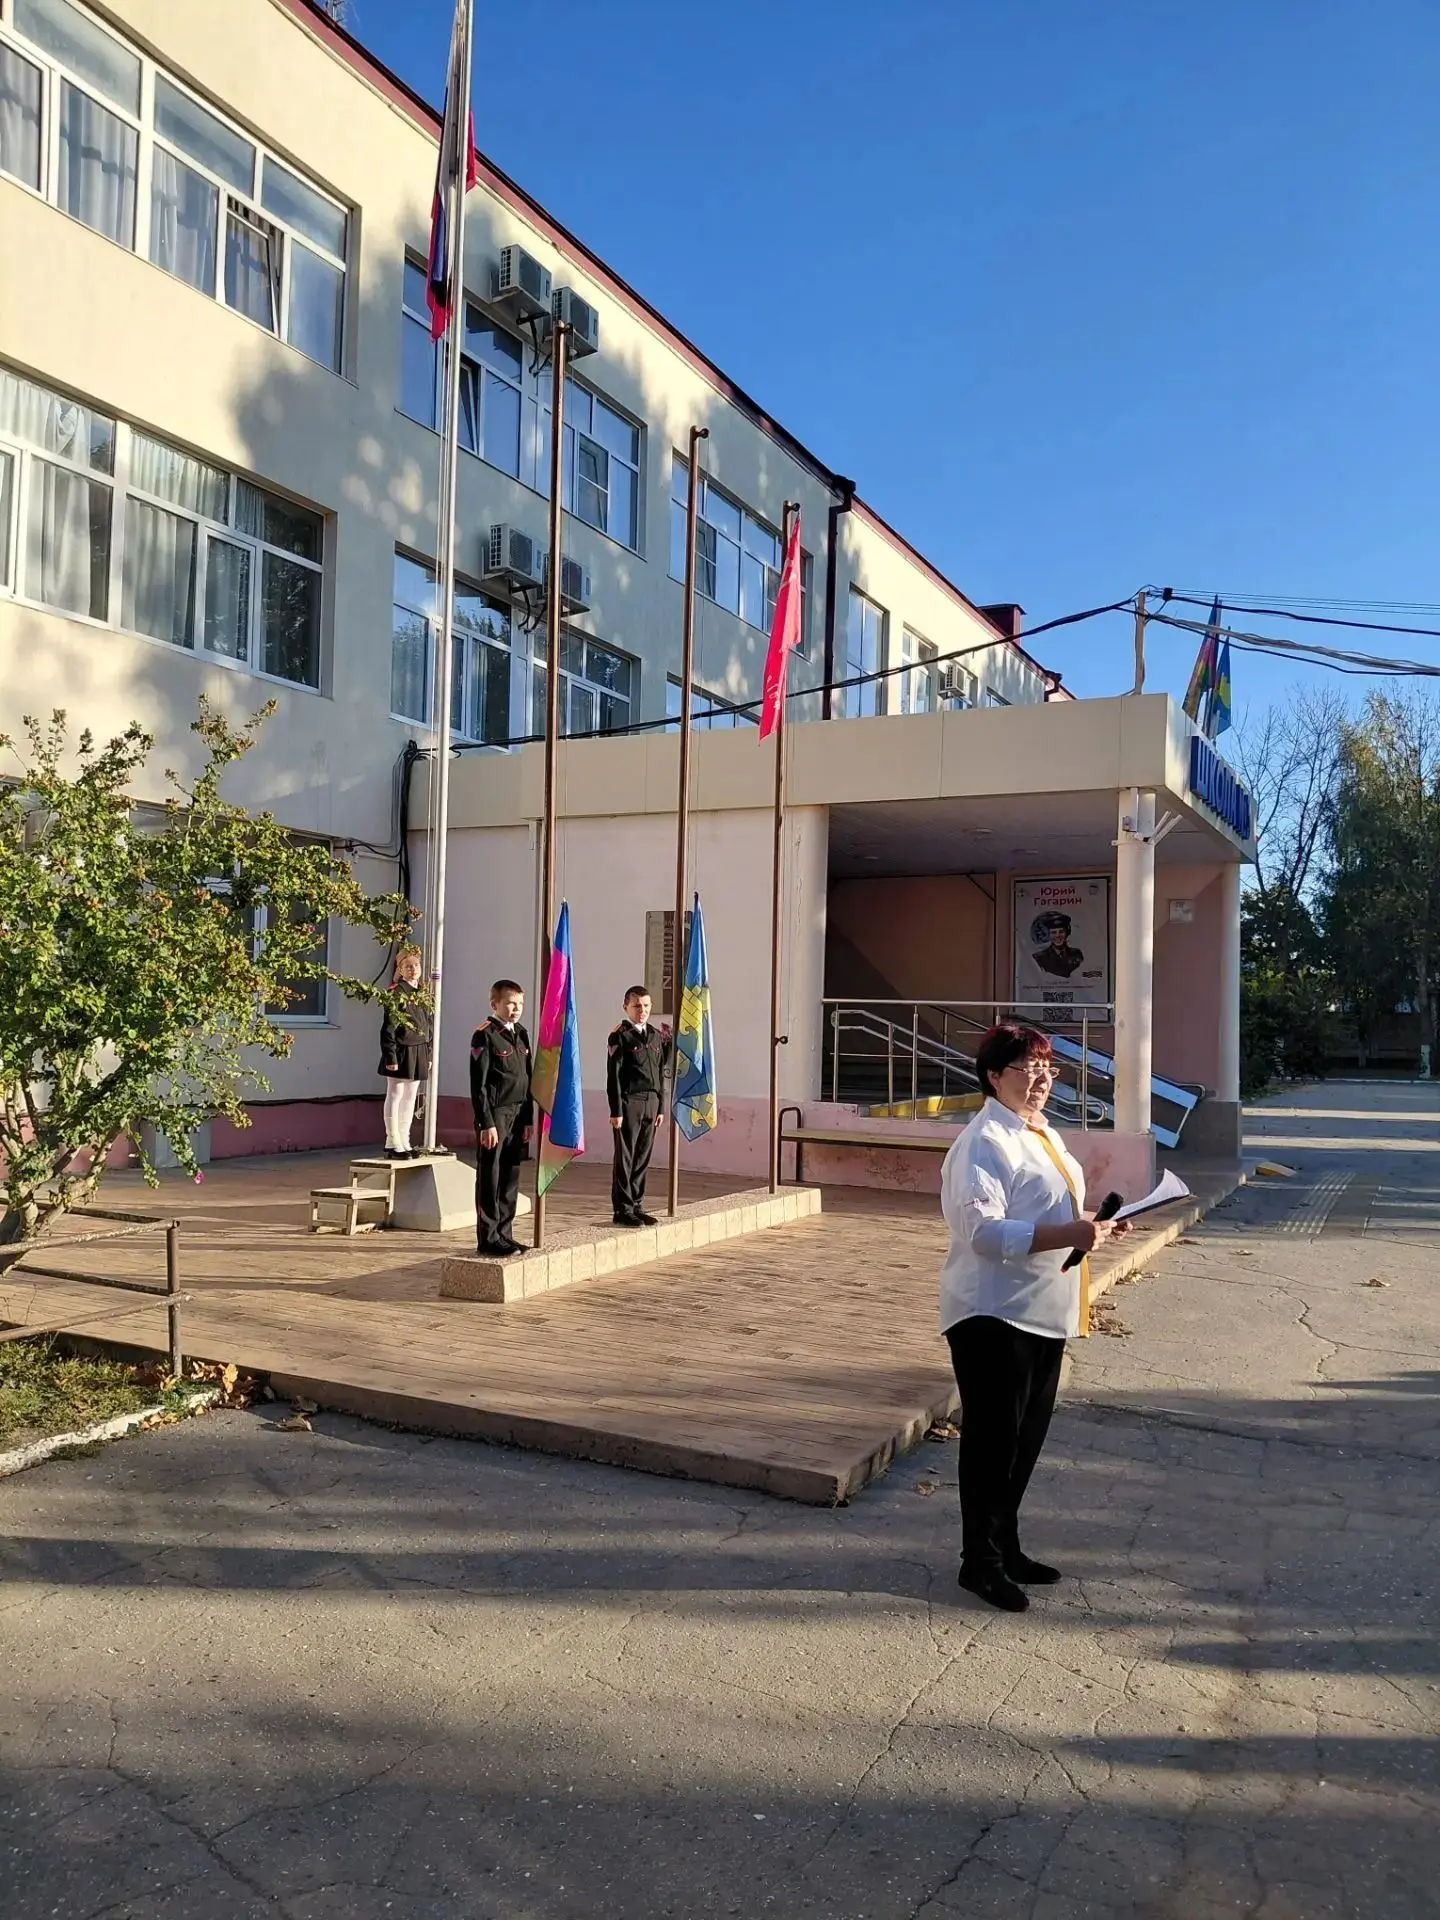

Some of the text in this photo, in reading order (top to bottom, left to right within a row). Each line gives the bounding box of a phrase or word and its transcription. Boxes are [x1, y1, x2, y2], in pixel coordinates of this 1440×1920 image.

[1192, 736, 1237, 828] ШКОЛА
[1040, 885, 1076, 898] Юрий
[1033, 896, 1082, 907] Гагарин
